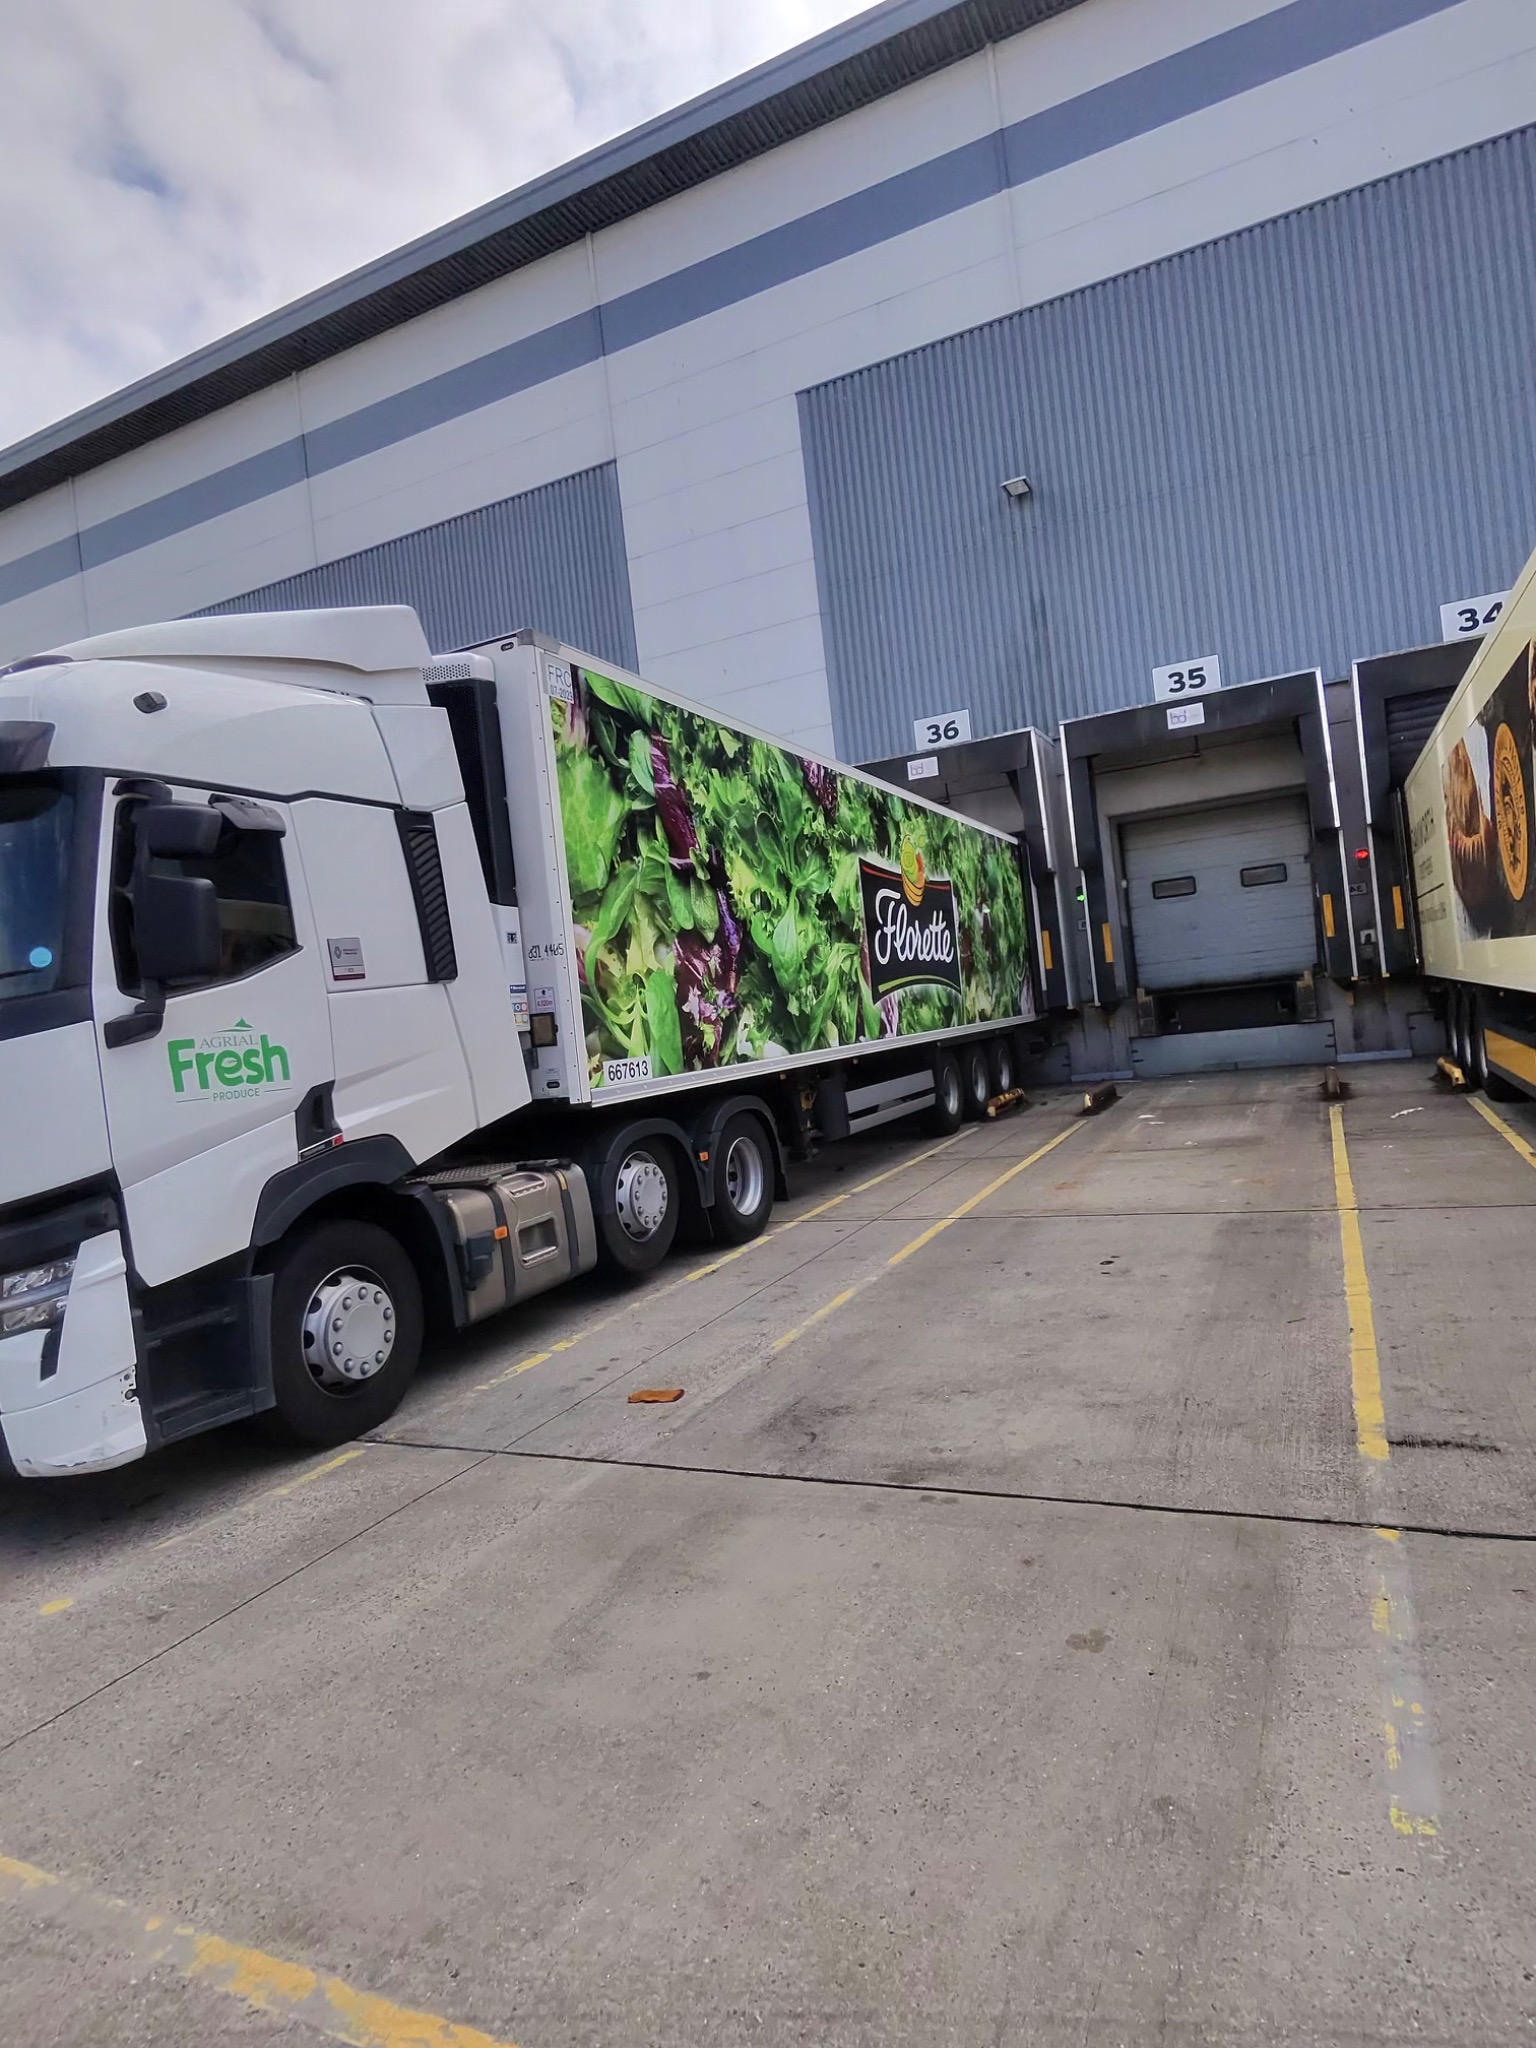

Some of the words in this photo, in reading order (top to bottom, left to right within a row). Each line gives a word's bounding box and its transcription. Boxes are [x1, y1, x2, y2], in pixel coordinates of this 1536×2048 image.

[1457, 601, 1503, 632] 34
[547, 664, 571, 688] FRC
[1168, 666, 1206, 693] 35
[926, 719, 959, 743] 36
[874, 888, 954, 965] Florette
[200, 1034, 258, 1049] AGRIAL
[167, 1033, 291, 1093] Fresh
[608, 1060, 649, 1081] 667613
[212, 1088, 260, 1102] PRODUCE
